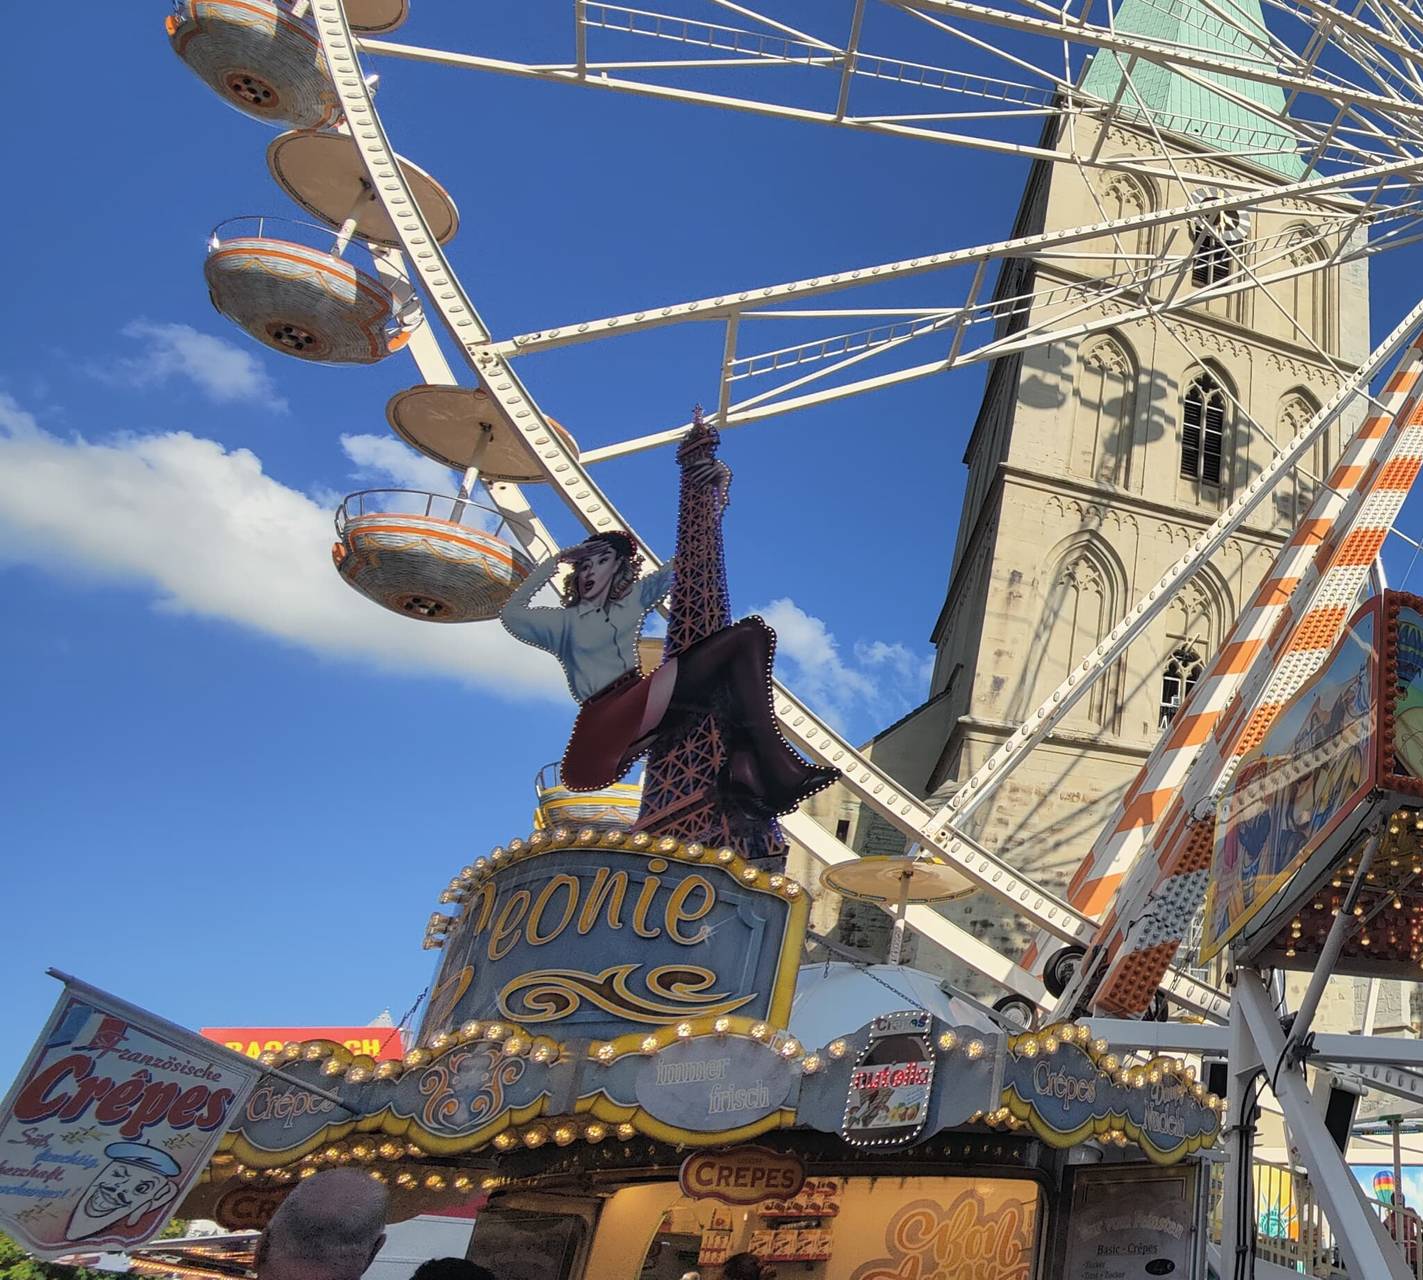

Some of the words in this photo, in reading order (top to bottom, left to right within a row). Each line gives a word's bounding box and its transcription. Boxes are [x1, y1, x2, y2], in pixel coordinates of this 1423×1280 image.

[656, 1057, 730, 1086] immer
[854, 1061, 929, 1089] nutella
[13, 1054, 237, 1140] Crêpes
[708, 1080, 769, 1114] frisch
[695, 1161, 795, 1189] CREPES
